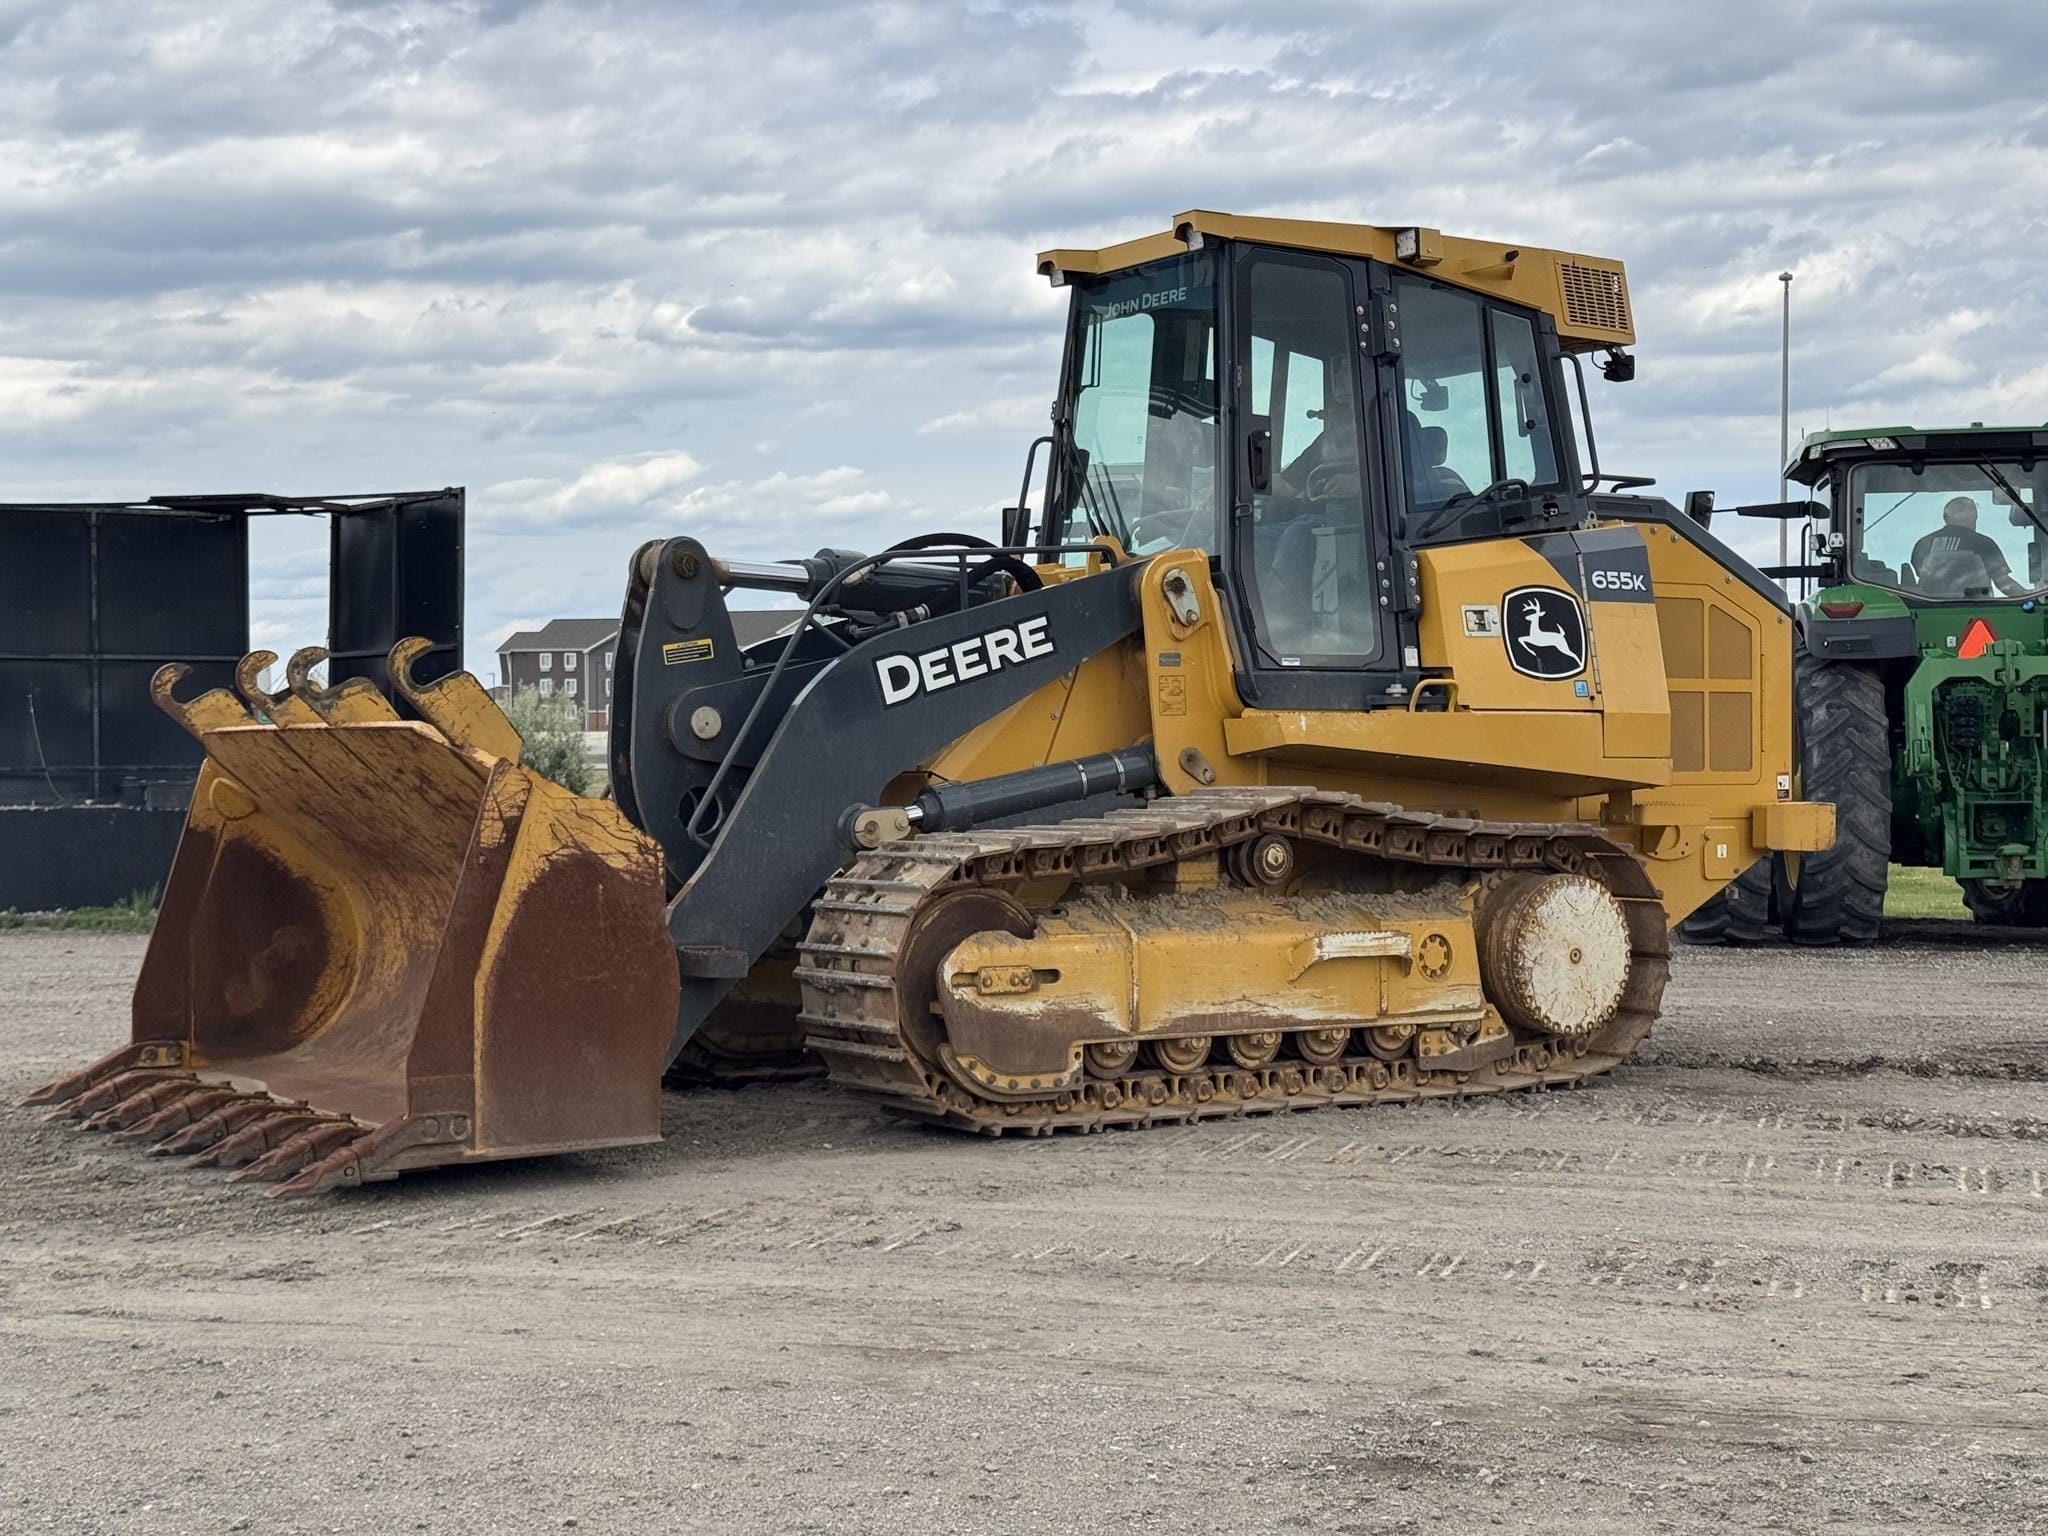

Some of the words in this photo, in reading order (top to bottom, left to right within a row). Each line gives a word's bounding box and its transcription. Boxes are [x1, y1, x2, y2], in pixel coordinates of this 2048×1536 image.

[1105, 298, 1139, 318] JOHN
[1142, 287, 1187, 309] DEERE
[1592, 570, 1647, 590] 655K
[876, 616, 1054, 705] DEERE
